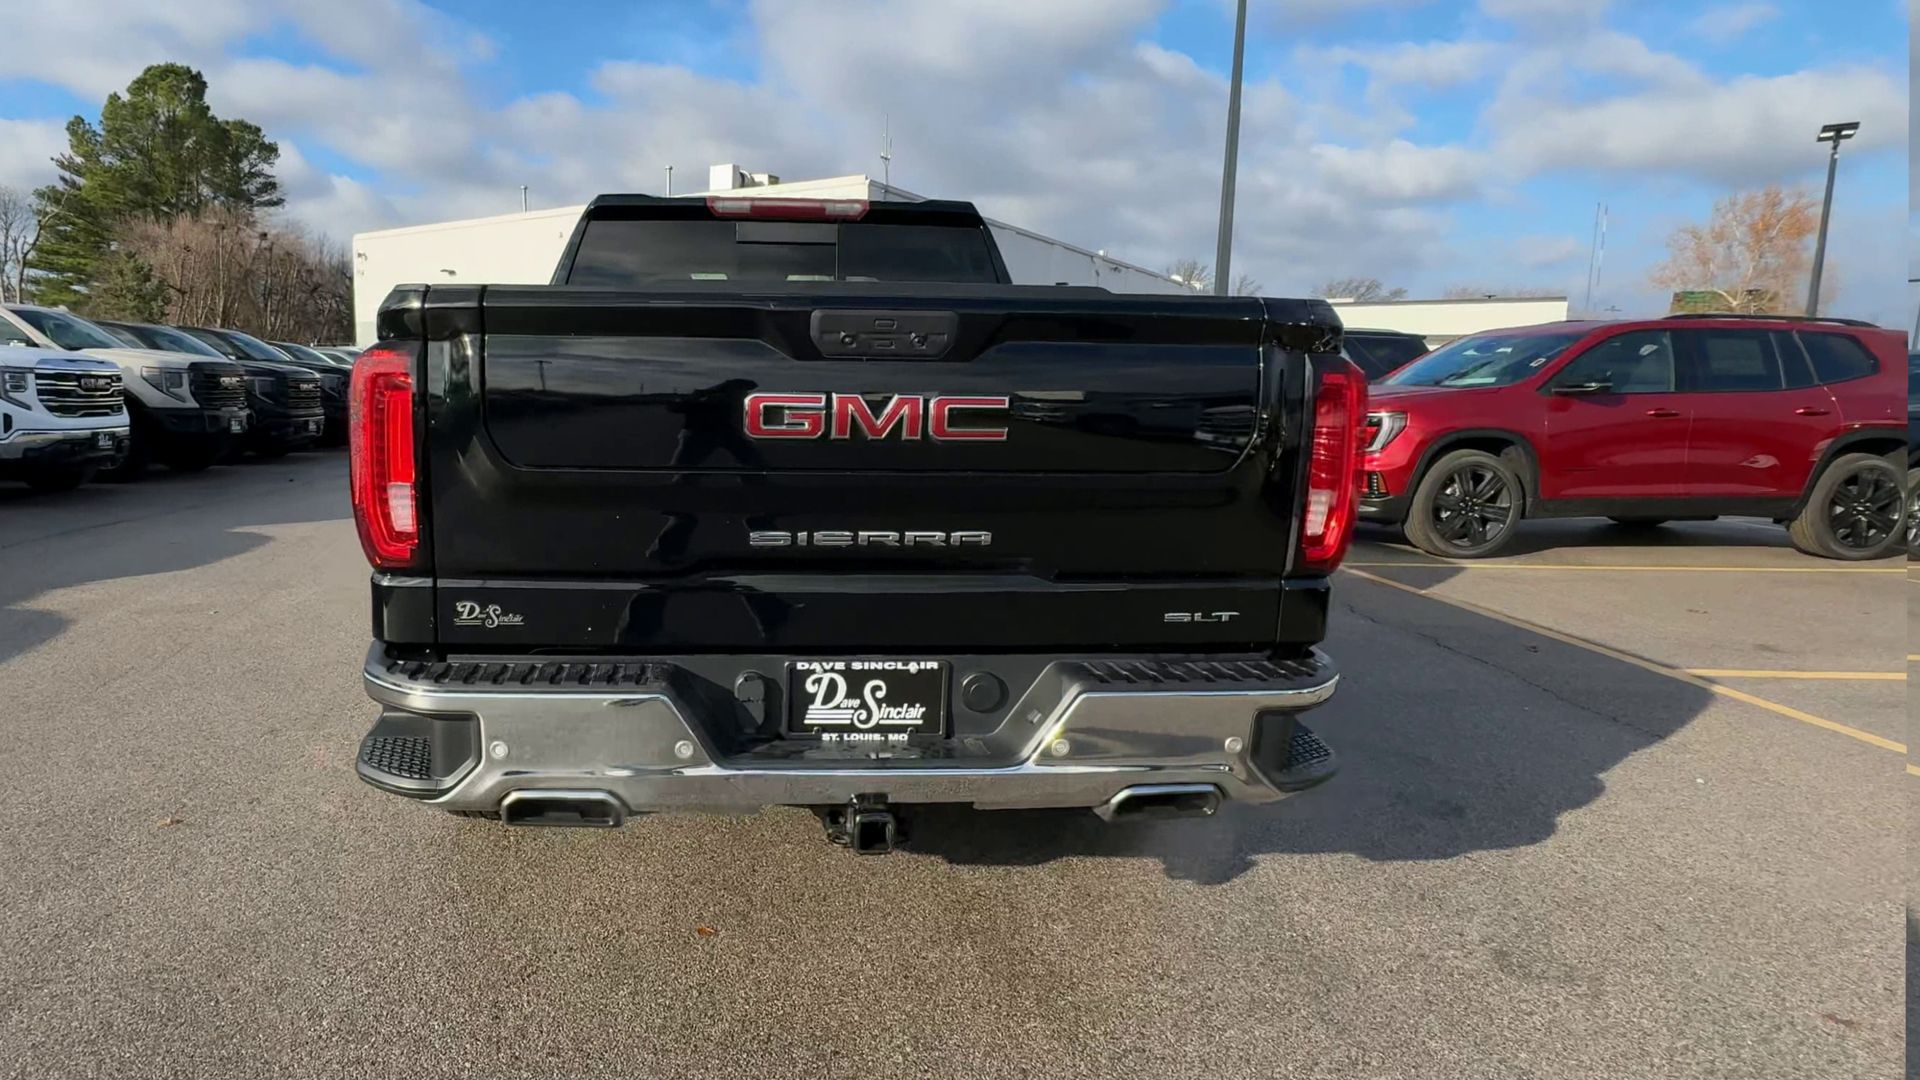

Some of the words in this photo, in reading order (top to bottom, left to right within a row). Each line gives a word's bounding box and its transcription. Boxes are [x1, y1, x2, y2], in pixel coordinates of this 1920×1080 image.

[744, 393, 1010, 441] GMC
[749, 531, 992, 546] SIERRA
[1164, 612, 1240, 622] SLT
[796, 661, 846, 670] DAVE
[851, 661, 939, 671] SINCLAIR
[805, 672, 861, 709] Dave
[853, 679, 926, 729] Sinclair
[822, 733, 840, 741] ST.
[888, 733, 909, 741] MO
